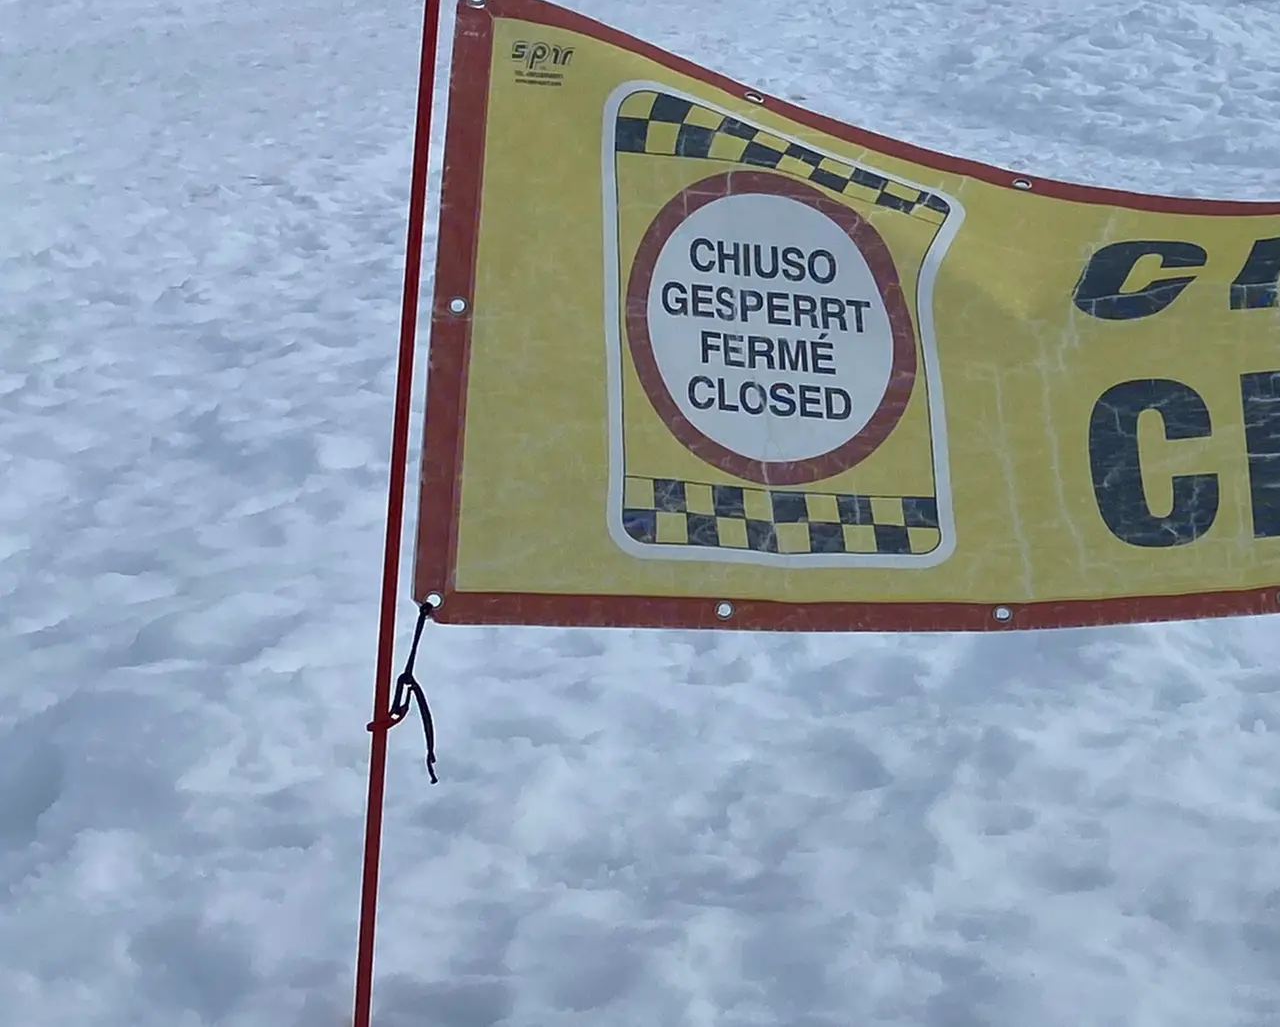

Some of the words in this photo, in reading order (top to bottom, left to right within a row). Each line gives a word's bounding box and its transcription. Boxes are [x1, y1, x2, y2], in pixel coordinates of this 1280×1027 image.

[689, 237, 837, 284] CHIUSO
[661, 281, 871, 333] GESPERRT
[700, 332, 837, 375] FERMÉ
[687, 375, 852, 420] CLOSED
